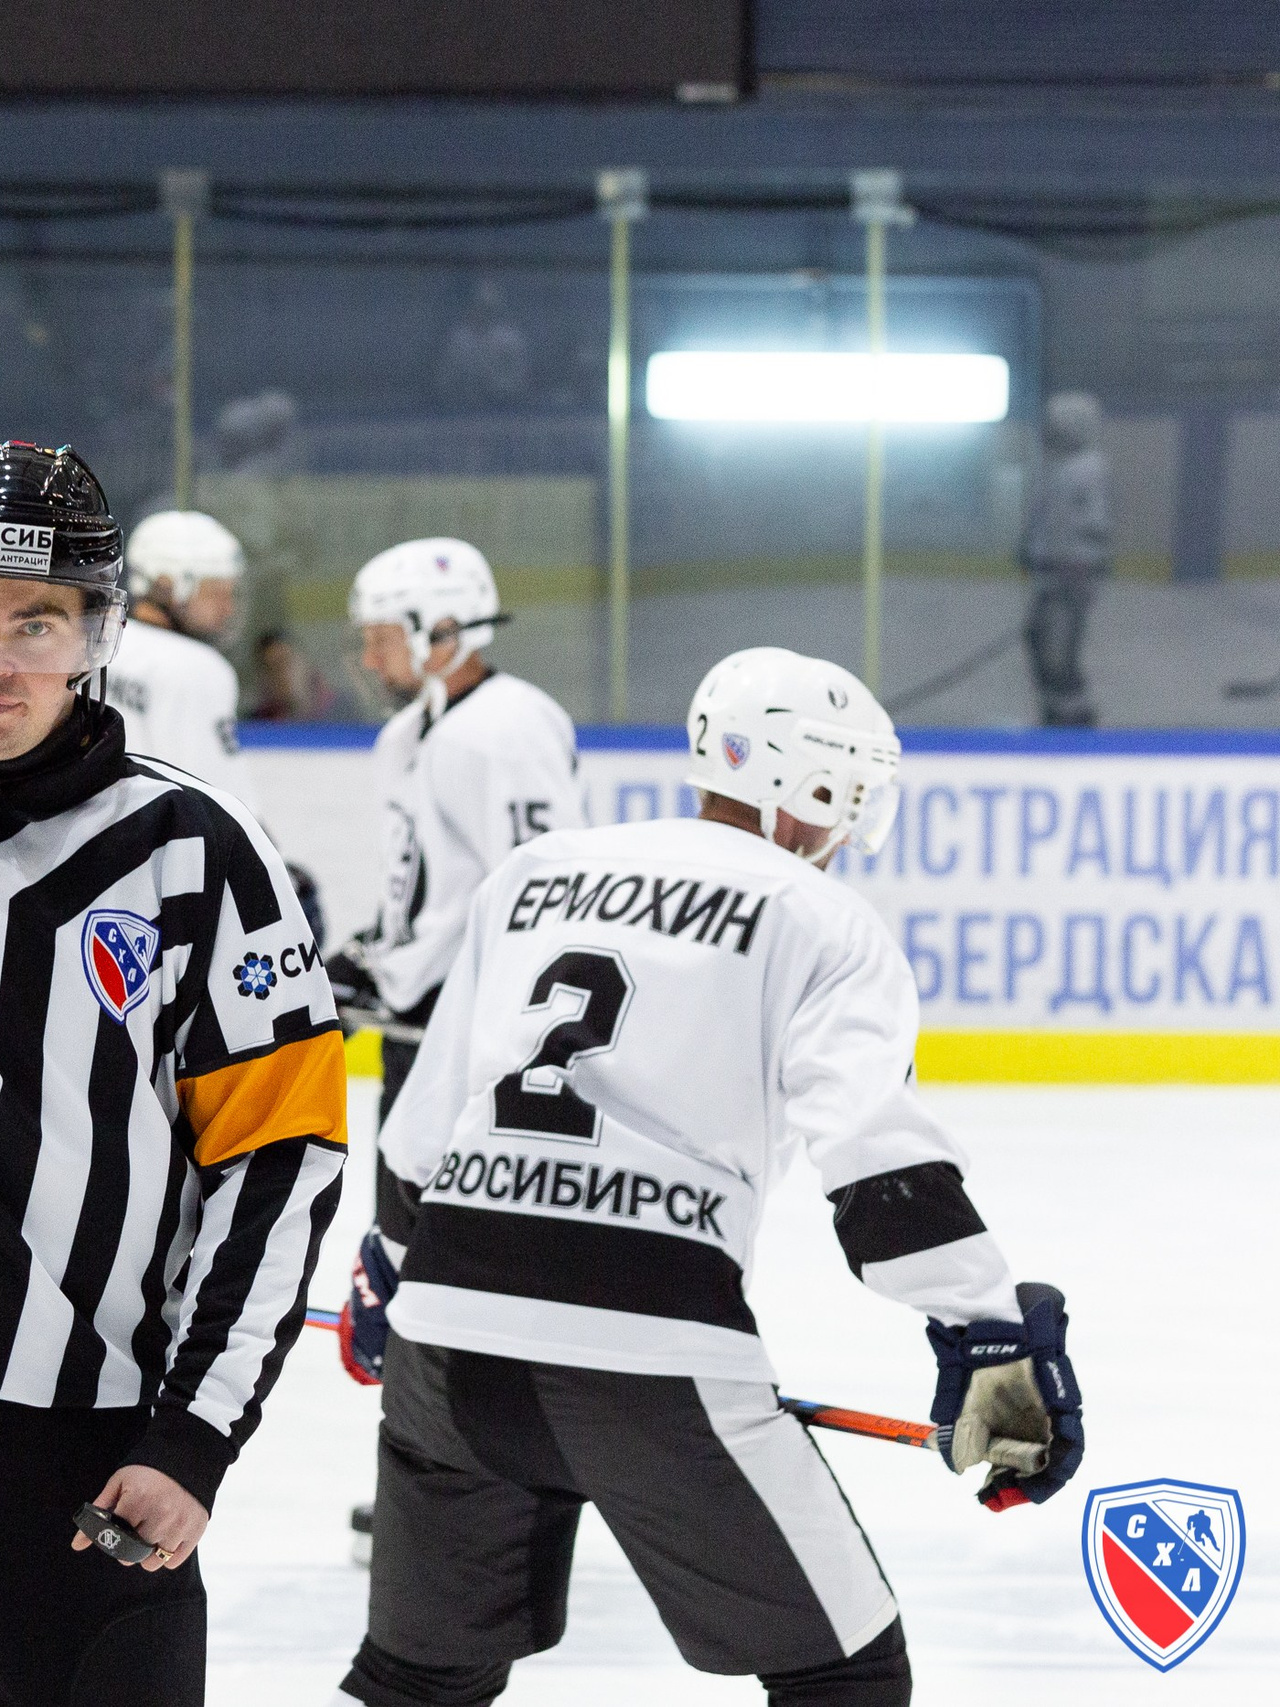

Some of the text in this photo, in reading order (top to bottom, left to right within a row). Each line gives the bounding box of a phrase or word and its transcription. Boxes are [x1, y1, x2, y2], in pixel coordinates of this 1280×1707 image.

[0, 527, 52, 549] СИБ
[0, 554, 49, 567] АНТРАЦИТ
[696, 713, 708, 756] 2
[614, 782, 1280, 888] ИСТРАЦИЯ
[506, 872, 768, 956] ЕРМОХИН
[903, 910, 1273, 1015] БЕРДСКА
[489, 944, 635, 1147] 2
[432, 1149, 727, 1240] ВОСИБИРСК
[970, 1344, 1018, 1356] CCM
